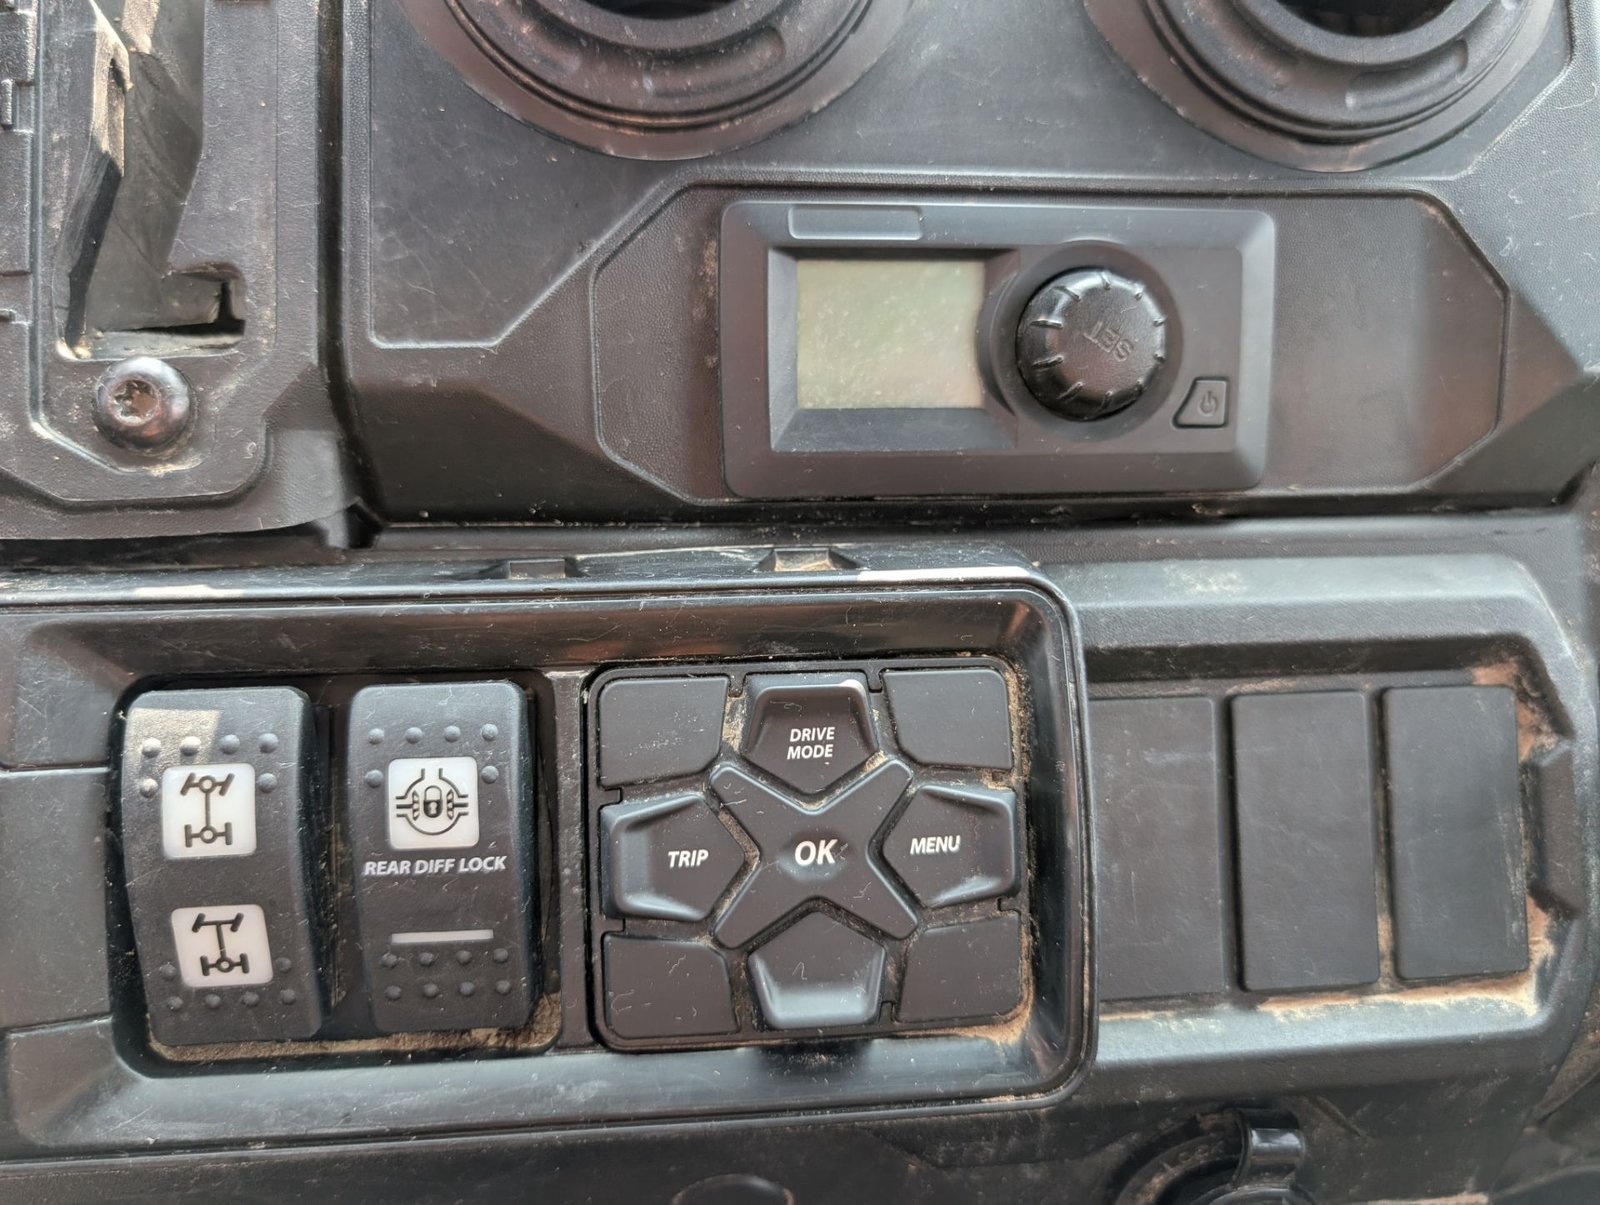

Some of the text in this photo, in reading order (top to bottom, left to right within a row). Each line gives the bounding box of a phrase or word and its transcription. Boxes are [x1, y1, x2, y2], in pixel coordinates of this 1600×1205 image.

[1083, 320, 1134, 362] SET
[790, 727, 835, 743] DRIVE
[787, 744, 834, 760] MODE
[794, 839, 838, 866] OK
[910, 835, 961, 855] MENU
[363, 856, 507, 875] REAR DIFF LOCK
[668, 849, 709, 868] TRIP
